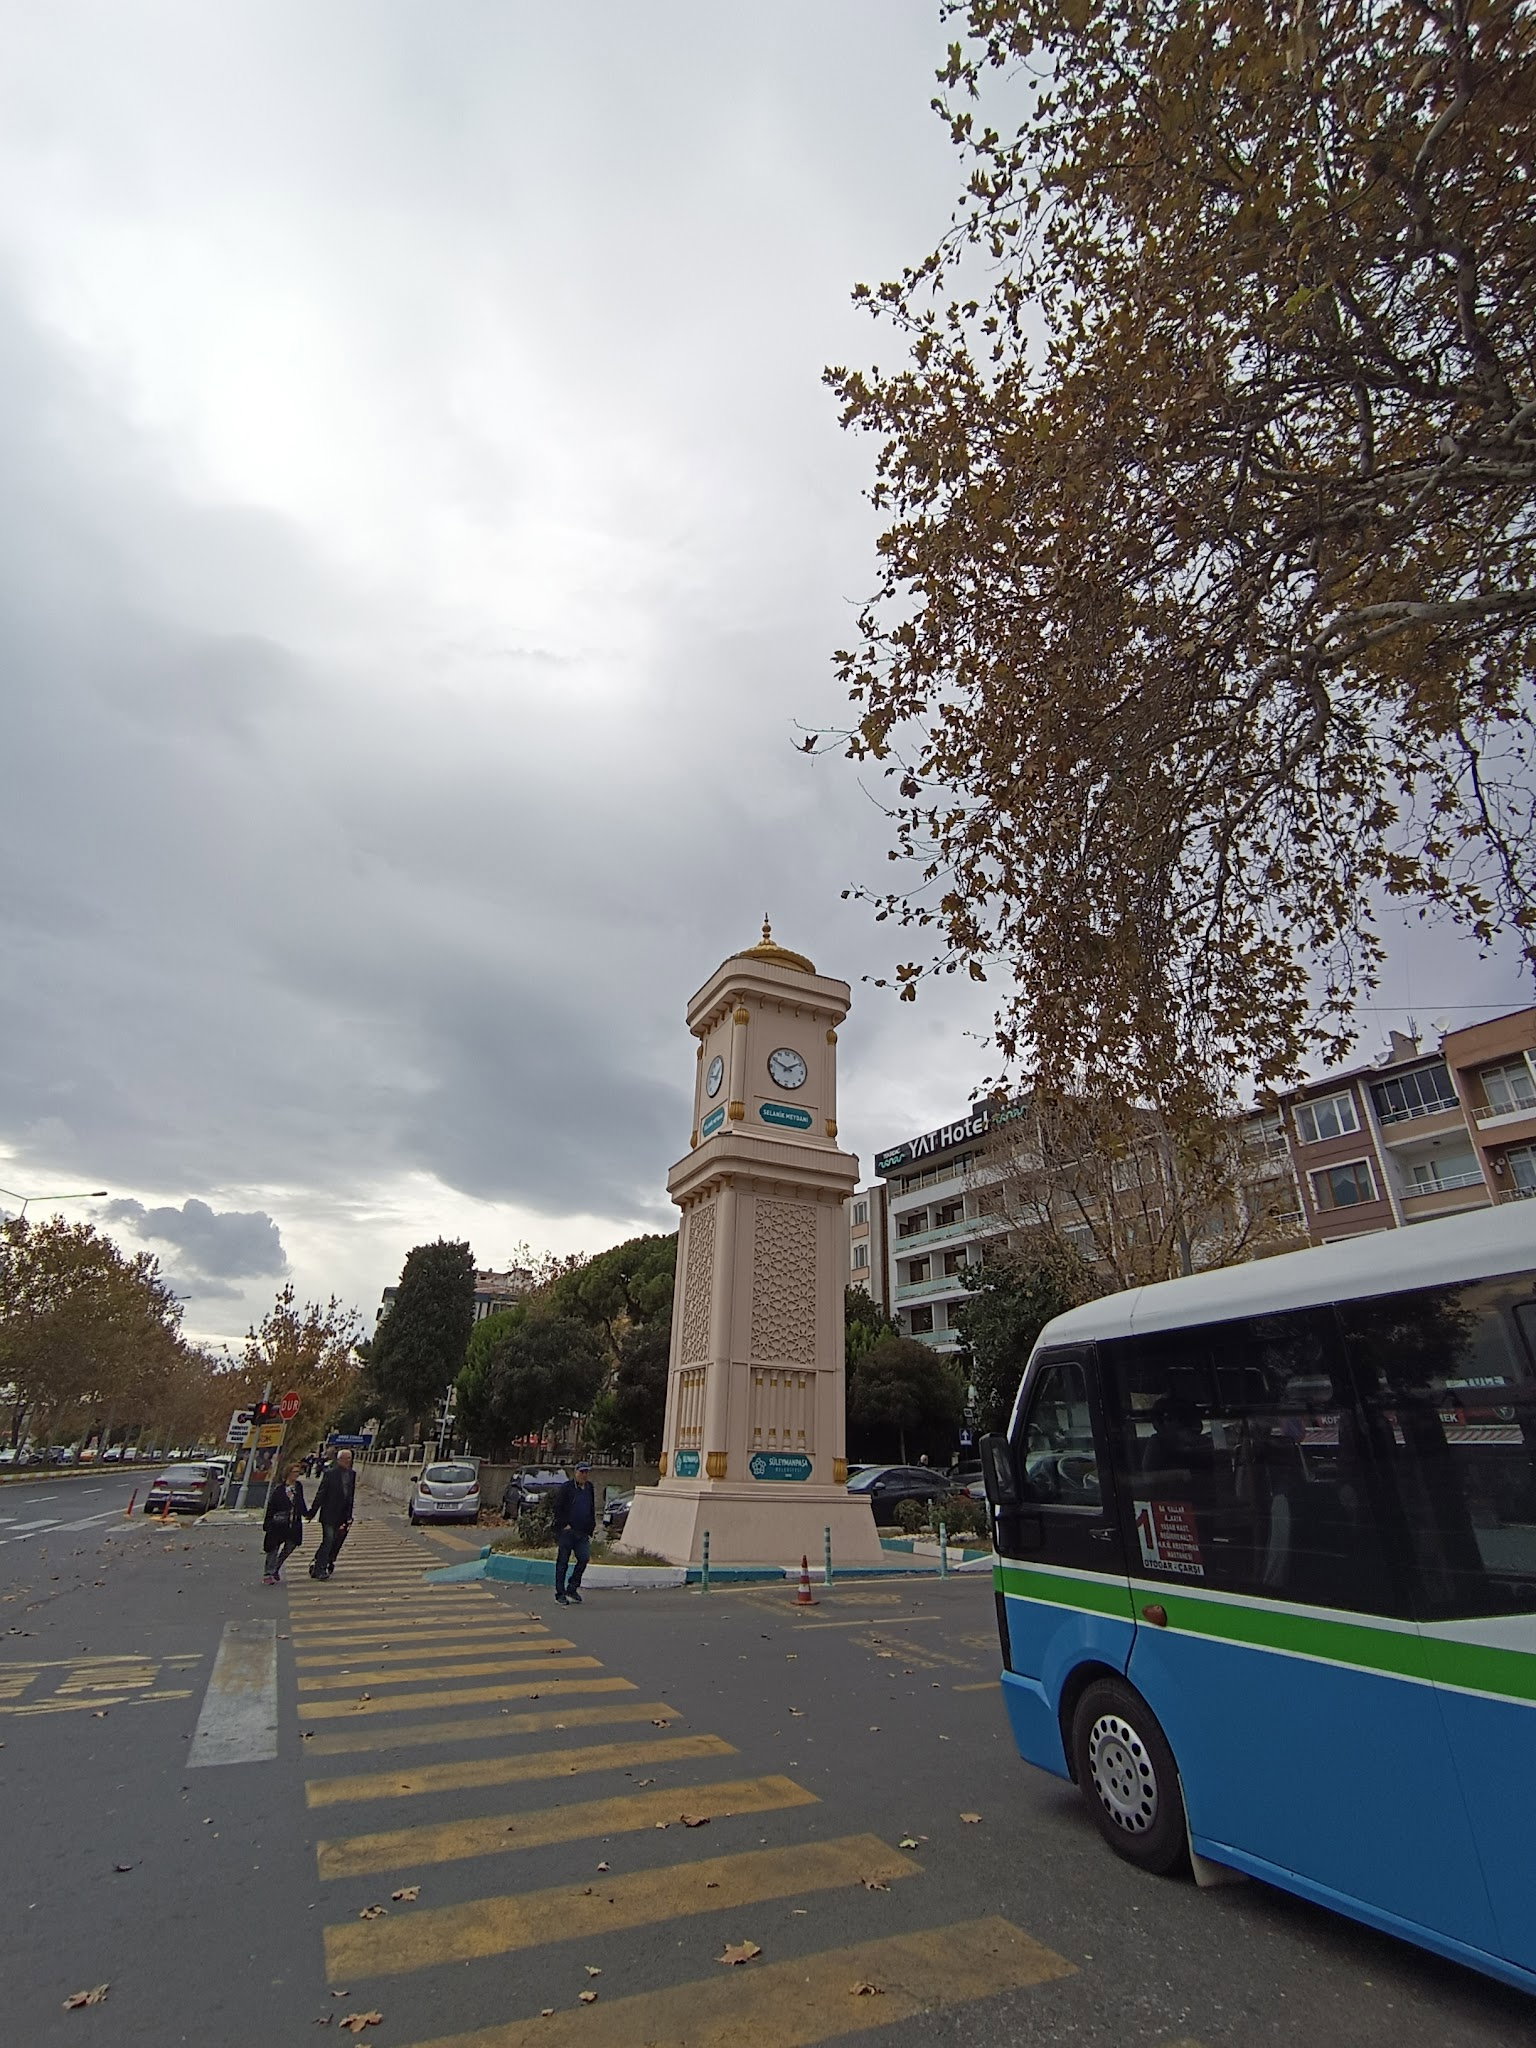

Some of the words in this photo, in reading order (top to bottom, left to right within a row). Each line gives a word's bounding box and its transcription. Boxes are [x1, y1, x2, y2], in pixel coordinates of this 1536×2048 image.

[763, 1109, 785, 1118] SELANİK
[786, 1113, 809, 1123] MEYDANI
[908, 1133, 937, 1159] YAT
[941, 1111, 989, 1147] Hotel
[281, 1400, 298, 1411] DUR
[769, 1457, 808, 1467] SÜLEYMANPAŞA
[1136, 1509, 1154, 1549] 1
[1144, 1560, 1172, 1570] OTOGAR
